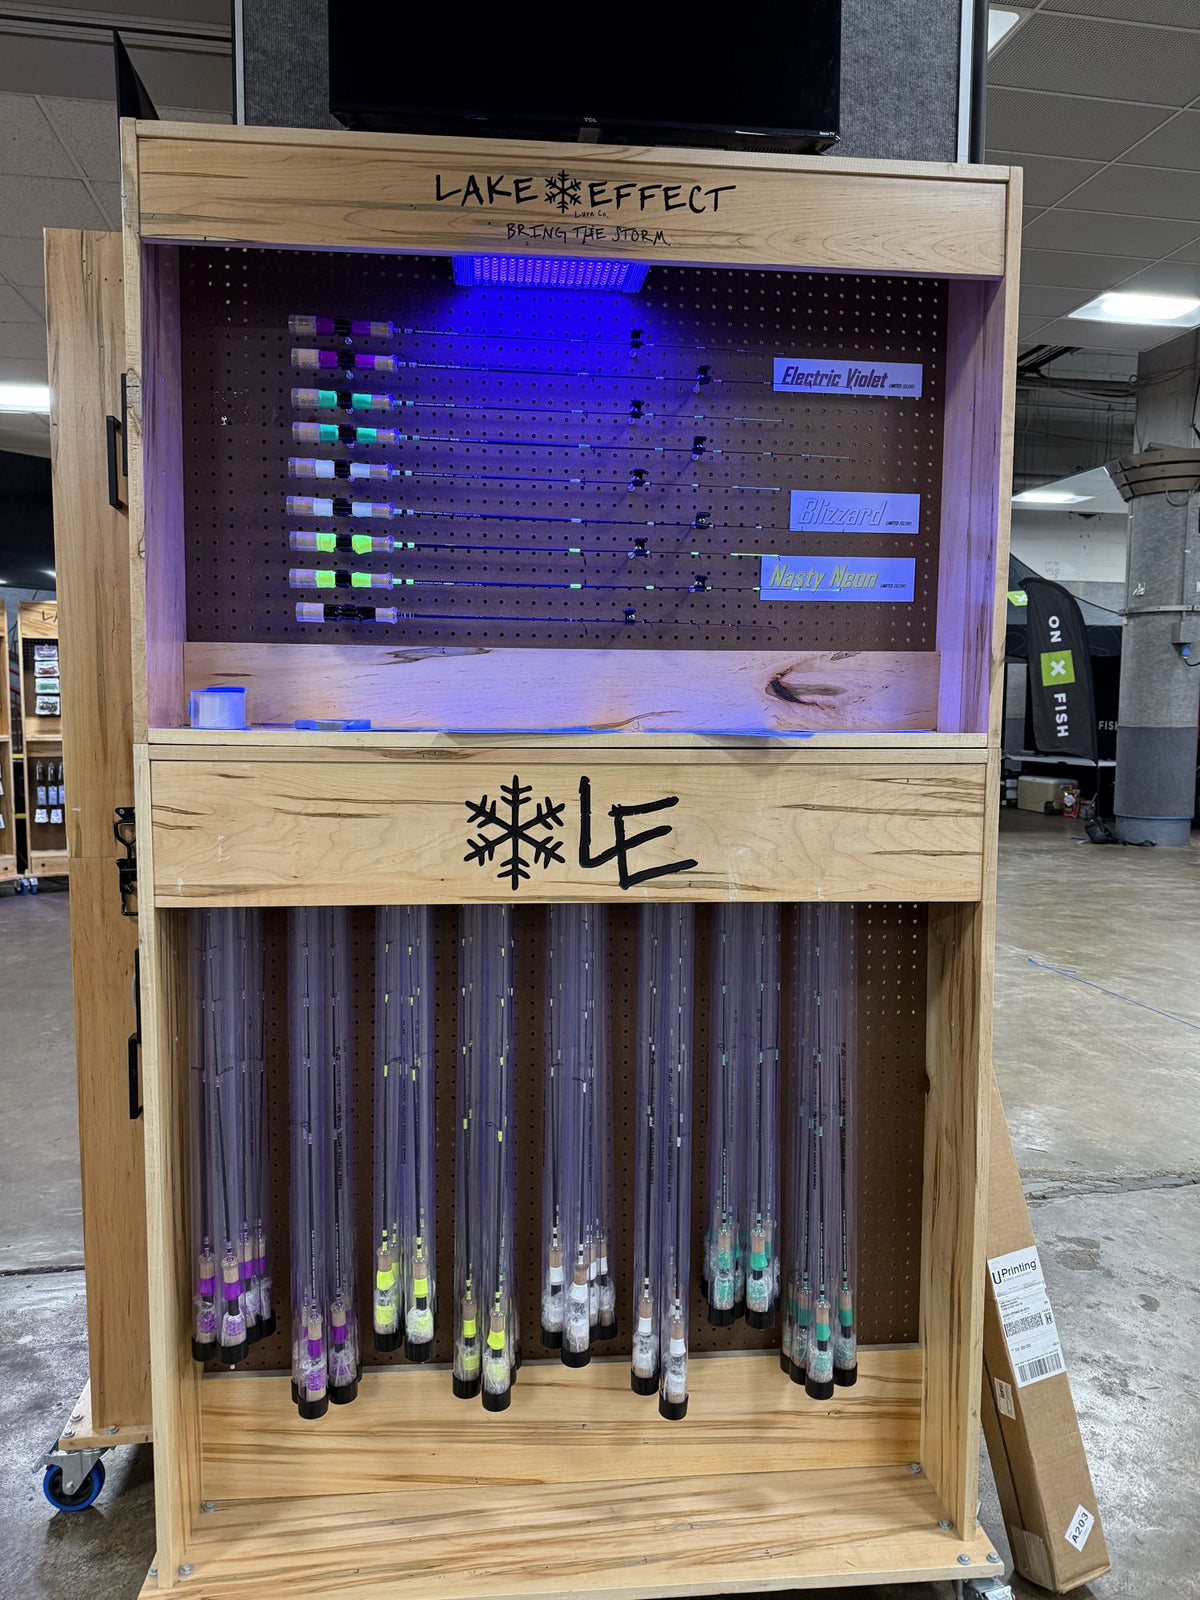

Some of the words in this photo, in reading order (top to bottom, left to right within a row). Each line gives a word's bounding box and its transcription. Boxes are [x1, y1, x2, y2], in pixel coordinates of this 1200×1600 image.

[435, 174, 539, 207] LAKE
[589, 181, 737, 214] EFFECT
[574, 210, 595, 219] Lure
[506, 223, 567, 244] BRING
[573, 225, 607, 245] THE
[612, 225, 671, 247] STORM
[782, 366, 842, 388] Electric
[847, 368, 889, 389] Violet
[799, 497, 888, 526] Blizzard
[769, 564, 826, 592] Nasty
[828, 565, 879, 589] Neon
[1048, 615, 1062, 643] ON
[1054, 693, 1069, 737] FISH
[992, 1259, 1037, 1285] UPrinting
[1071, 1512, 1089, 1544] A203
